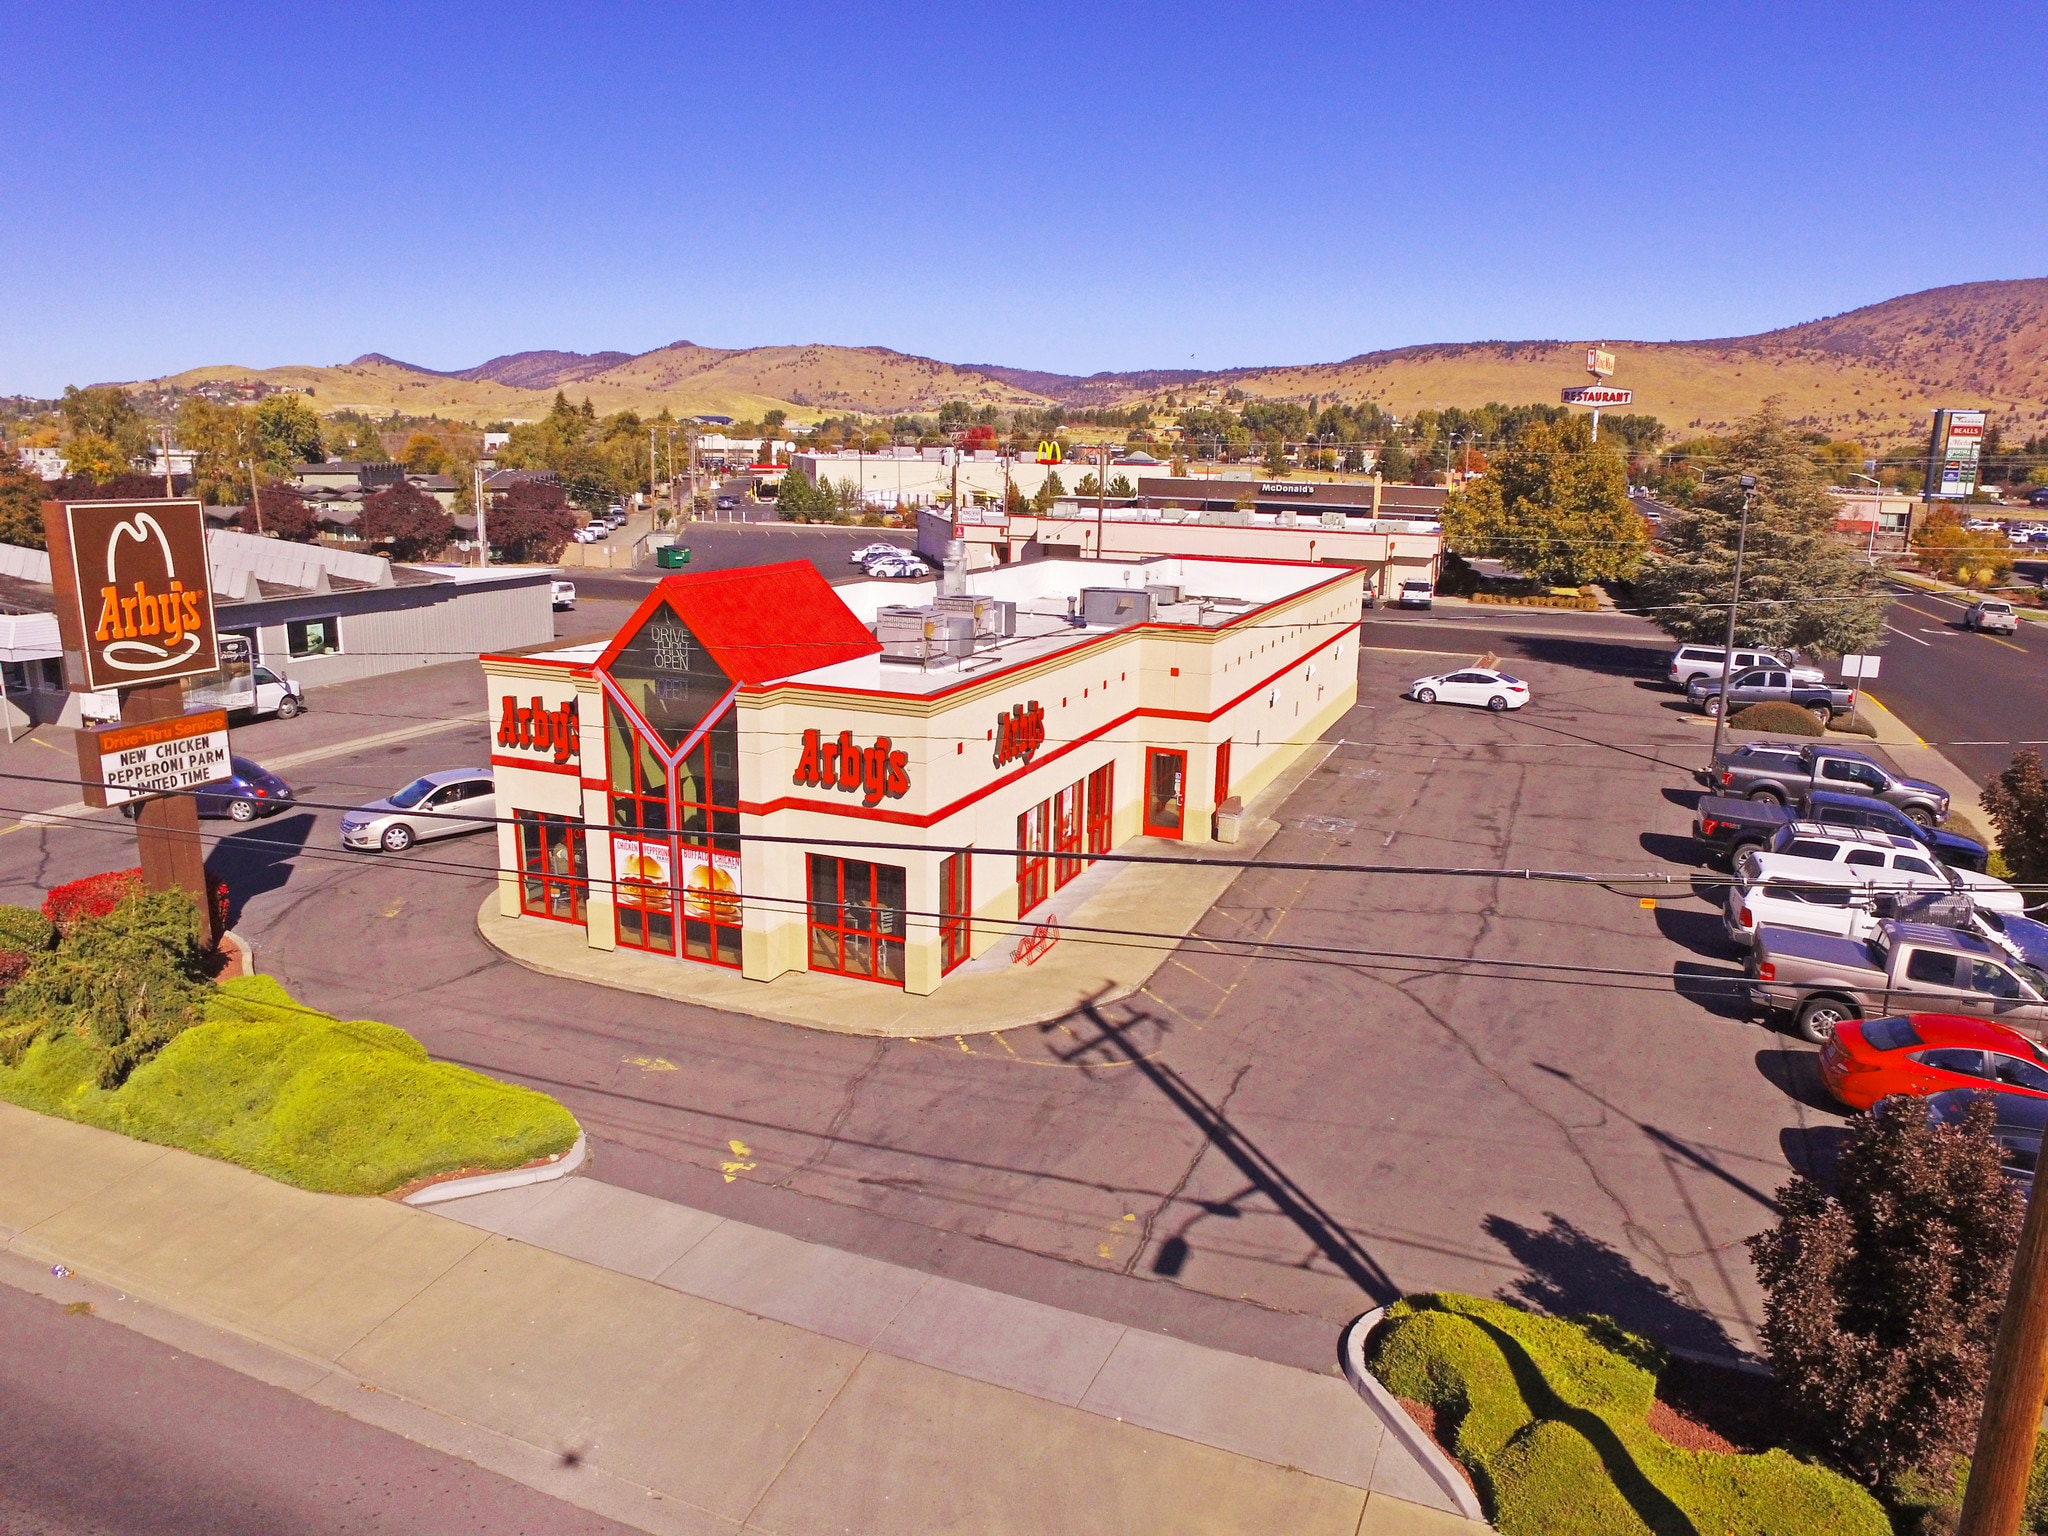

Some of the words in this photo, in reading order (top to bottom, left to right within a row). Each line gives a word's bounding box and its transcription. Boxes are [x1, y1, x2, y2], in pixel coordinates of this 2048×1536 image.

[1563, 391, 1630, 402] RESTAURANT
[1262, 484, 1314, 493] McDonald's
[95, 581, 202, 646] Arby's
[651, 627, 689, 643] DRIVE
[655, 641, 688, 657] THRU
[654, 654, 689, 670] OPEN
[103, 728, 172, 750] Drive-Thru
[174, 716, 224, 735] Service
[992, 700, 1045, 769] Arby's
[120, 749, 147, 766] NEW
[155, 736, 210, 758] CHICKEN
[108, 757, 184, 785] PEPPERONI
[189, 749, 225, 767] PARM
[793, 728, 911, 808] Arby's
[129, 776, 178, 797] LIMITED
[180, 768, 210, 785] TIME
[714, 854, 740, 867] CHICKEN
